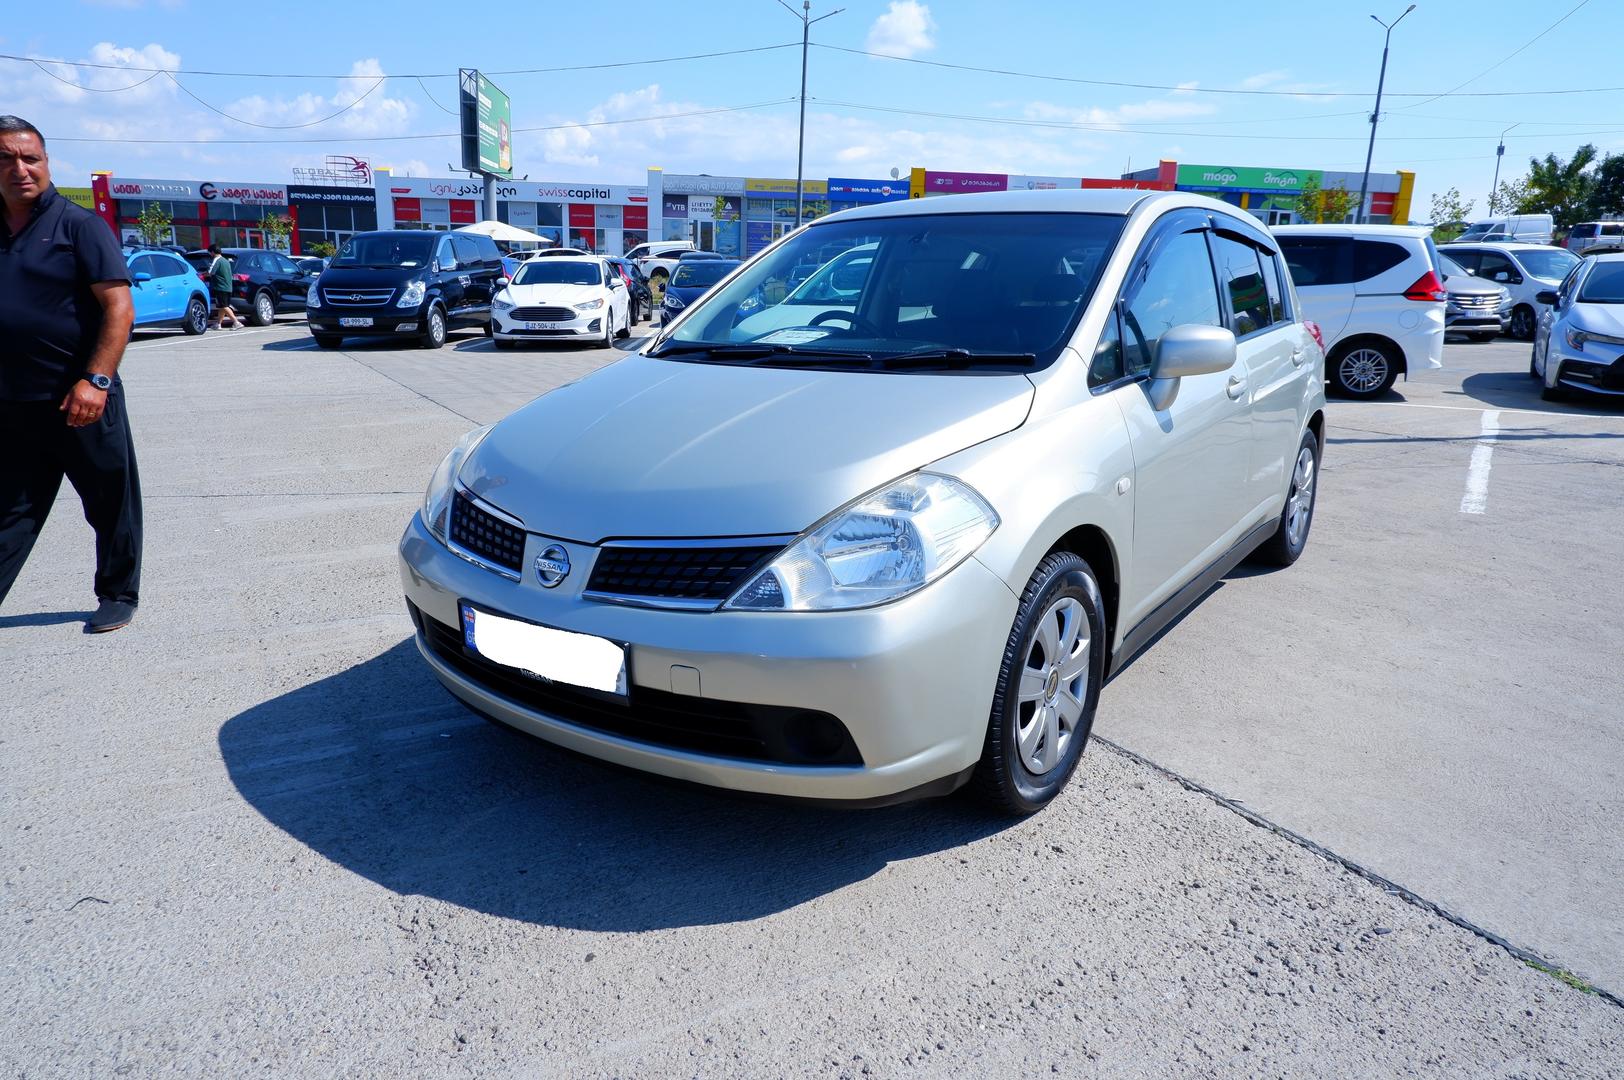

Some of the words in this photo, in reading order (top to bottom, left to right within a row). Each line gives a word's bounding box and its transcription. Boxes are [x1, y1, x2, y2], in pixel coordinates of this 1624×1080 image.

[1202, 172, 1237, 185] mogo
[1263, 172, 1298, 187] მოგო
[222, 188, 251, 198] ავტო
[253, 189, 284, 200] სესხი
[99, 202, 106, 211] 6
[536, 560, 564, 572] NISSAN
